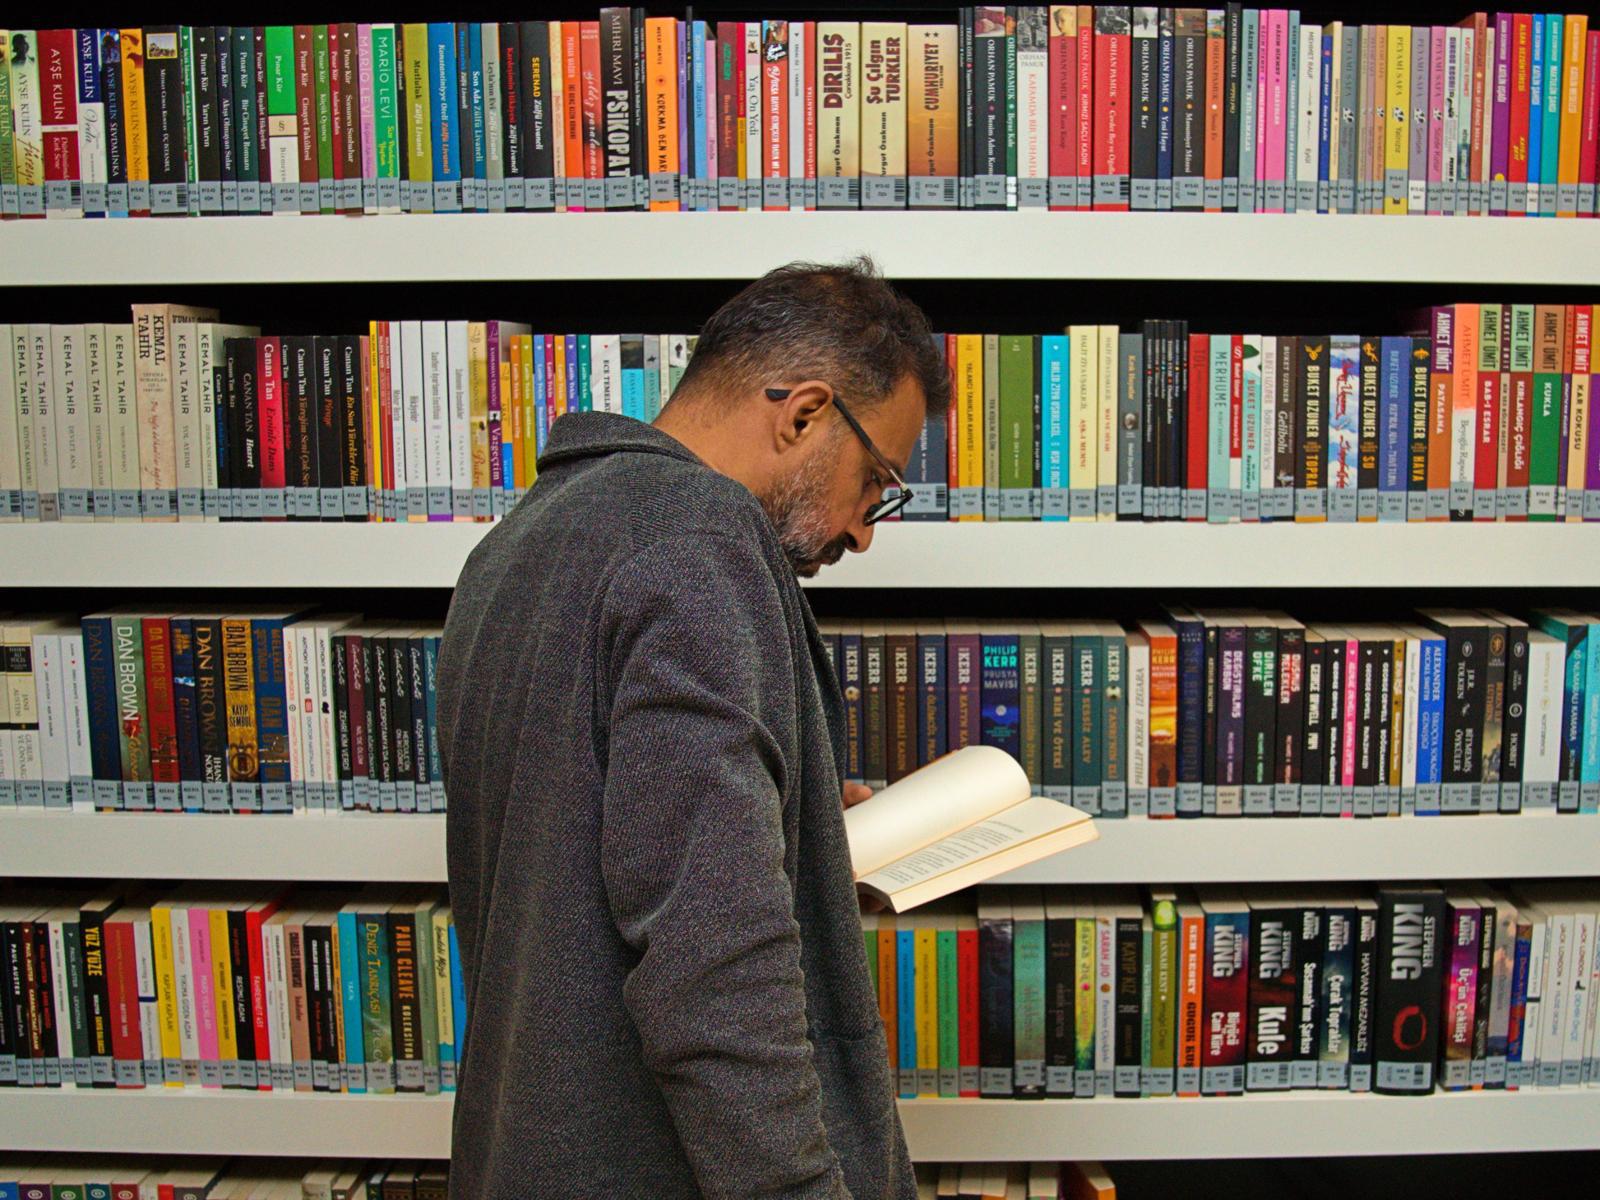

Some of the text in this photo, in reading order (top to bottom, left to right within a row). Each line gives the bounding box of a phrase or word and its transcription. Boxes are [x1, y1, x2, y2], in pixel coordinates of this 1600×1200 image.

[82, 34, 93, 98] AYŞE KULİN
[199, 53, 208, 74] Pınar
[240, 52, 248, 72] Pınar
[844, 43, 852, 60] 1915
[50, 48, 64, 119] AYŞE KULİN
[240, 74, 248, 88] Kür
[378, 37, 393, 118] MARİO LEVİ
[865, 40, 883, 104] Şu Çılgın
[924, 44, 939, 110] CUMHURİYET
[242, 99, 250, 111] Bir
[472, 71, 483, 162] Son Ada Zülfü Livaneli
[532, 57, 544, 150] SERENAD Zülfü Livaneli
[657, 94, 666, 130] KORKMA
[748, 76, 760, 136] Yaş On Yedi
[203, 126, 211, 147] Yarın
[242, 112, 250, 140] Cinayet
[1160, 133, 1168, 152] Hayat
[110, 123, 119, 177] SEVDALİNKA
[659, 155, 668, 173] VARI
[138, 315, 150, 358] TAHİR
[153, 315, 166, 365] KEMAL
[1484, 310, 1496, 342] AHMET
[1516, 310, 1529, 342] AHMET
[1576, 313, 1589, 344] AHMET
[17, 336, 29, 415] KEMAL TAHİR
[63, 336, 74, 415] KEMAL TAHİR
[115, 335, 126, 414] KEMAL TAHİR
[264, 344, 273, 377] Canan
[323, 348, 331, 377] Canan
[1436, 312, 1452, 434] AHMET ÜMİT PATASANA
[1483, 346, 1497, 368] ÜMİT
[1515, 346, 1529, 367] ÜMİT
[1543, 312, 1558, 416] AHMET ÜMİT KUKLA
[1574, 347, 1588, 371] ÜMİT
[243, 373, 252, 409] CANAN
[265, 382, 274, 400] Tan
[324, 378, 332, 395] Tan
[1214, 352, 1228, 407] MERHUME
[1363, 366, 1377, 468] BUKET UZUNER SU
[1413, 367, 1427, 481] BUKET UZUNER HAVA
[1515, 381, 1525, 432] KIRLANGIÇ
[1277, 411, 1288, 453] Gelibolu
[1306, 365, 1320, 489] BUKET UZUNER TOPRA
[1482, 411, 1491, 443] ESRAR
[1574, 409, 1583, 449] KOKUSU
[246, 438, 254, 468] Hasret
[268, 447, 276, 472] Dans
[490, 427, 501, 480] Vazgeçtim
[195, 627, 213, 669] DAN
[226, 627, 248, 691] DAN BROWN
[984, 646, 1017, 654] PHILIP
[984, 656, 1017, 668] KERR
[1108, 650, 1119, 681] KERR
[117, 626, 138, 720] DAN BROWN
[868, 652, 879, 684] KERR
[925, 652, 936, 683] KERR
[1052, 653, 1064, 684] KERR
[396, 926, 410, 952] PAUL
[1303, 912, 1315, 939] KING
[1361, 916, 1371, 942] KING
[1391, 904, 1424, 979] KING
[1423, 916, 1435, 967] STEPHEN
[1459, 915, 1471, 945] KING
[85, 927, 102, 976] YÜZ YÜZE
[1213, 925, 1234, 977] KING
[1234, 934, 1243, 968] STEPHEN
[1282, 931, 1291, 968] STEPHEN
[398, 958, 413, 999] CLEAVE
[1258, 921, 1286, 1054] KING Kule
[1326, 915, 1343, 1053] KING Çorak Topraklar
[1359, 953, 1370, 995] HAYVAN
[1453, 1003, 1468, 1043] Çekilişi
